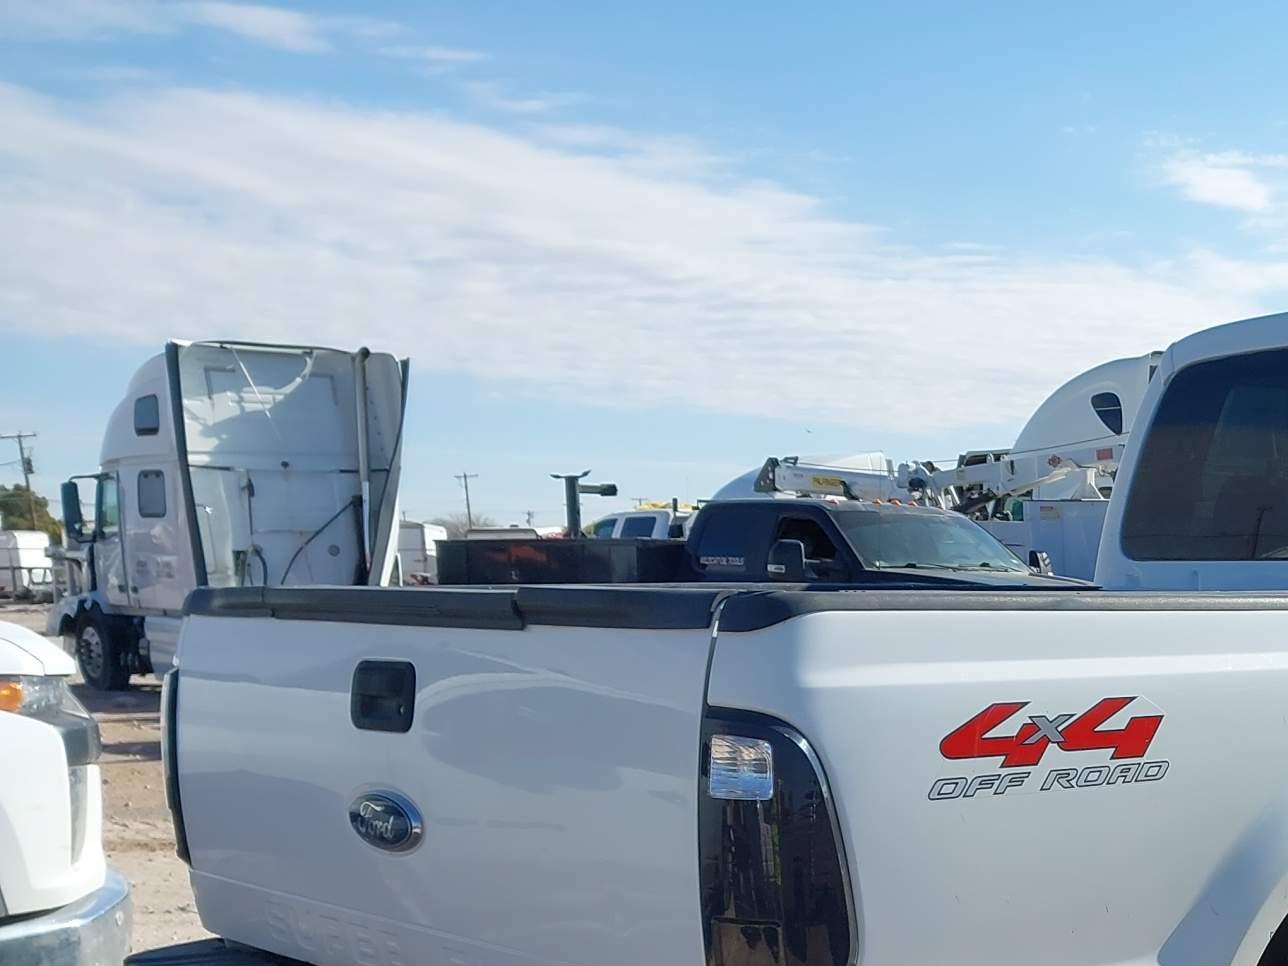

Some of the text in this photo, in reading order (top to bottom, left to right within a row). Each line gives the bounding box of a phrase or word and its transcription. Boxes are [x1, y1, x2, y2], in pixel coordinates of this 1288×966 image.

[927, 760, 1170, 801] OFF ROAD
[357, 800, 395, 840] Ford
